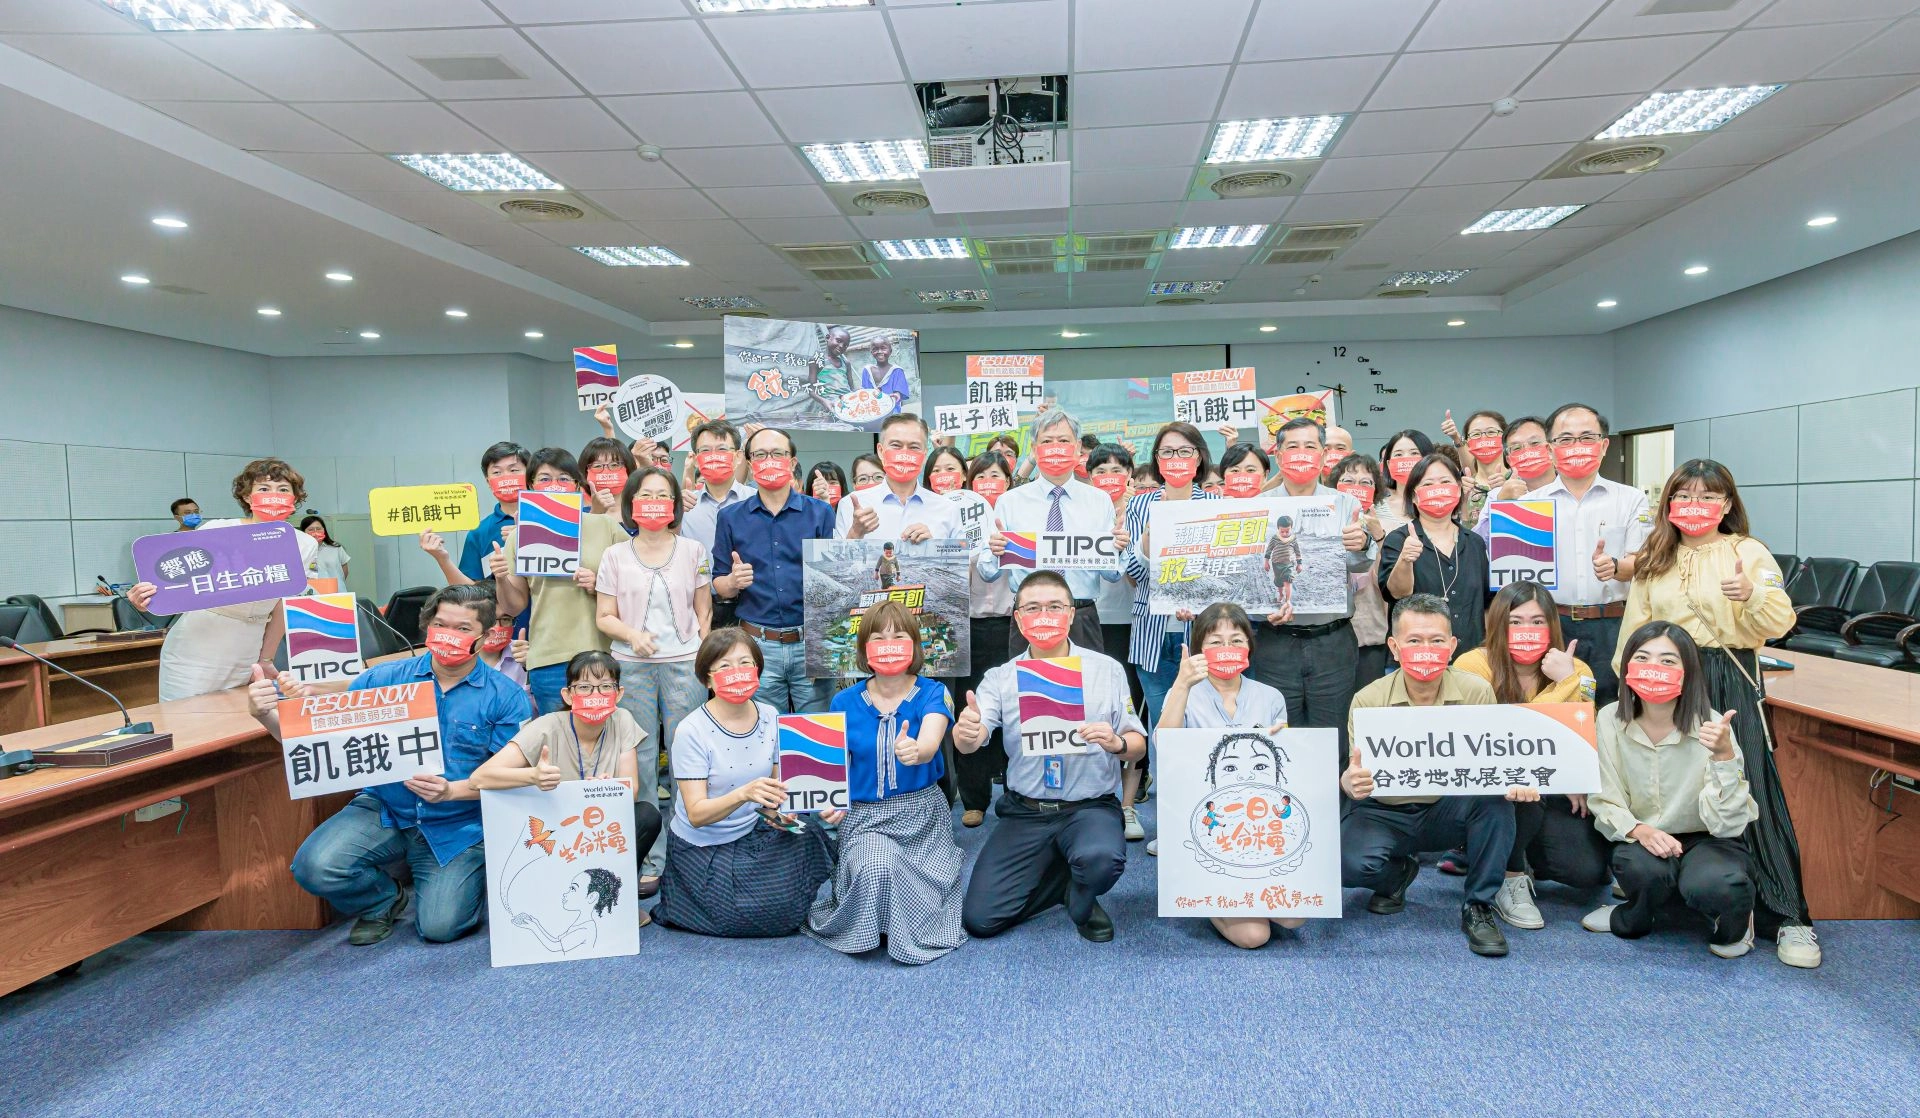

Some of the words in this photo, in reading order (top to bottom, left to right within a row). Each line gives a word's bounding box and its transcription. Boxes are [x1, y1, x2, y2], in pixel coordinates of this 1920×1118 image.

[1333, 346, 1347, 357] 12
[1221, 368, 1247, 380] NOW
[1151, 383, 1171, 391] TIPC
[1374, 384, 1398, 394] Three
[617, 386, 673, 423] 飢餓中
[939, 406, 1013, 432] 肚子餓
[895, 453, 917, 463] RESCUE
[1565, 447, 1593, 457] RESCUE
[1426, 488, 1451, 498] RESCUE
[387, 503, 461, 523] #飢餓中
[1679, 507, 1710, 516] RESCUE
[1042, 536, 1115, 556] TIPC
[1166, 546, 1208, 555] RESCUE
[1209, 548, 1237, 557] NOW!
[159, 549, 210, 579] 響應
[517, 556, 578, 574] TIPC
[164, 563, 291, 595] 一日生命糧
[1491, 568, 1555, 586] TIPC
[1033, 616, 1059, 626] RESCUE
[434, 633, 461, 647] RESCUE
[1513, 632, 1540, 641] RESCUE
[878, 645, 905, 655] RESCUE
[1216, 651, 1242, 661] RESCUE
[1413, 651, 1440, 661] RESCUE
[291, 658, 361, 681] TIPC
[1638, 667, 1669, 680] RESCUE
[725, 671, 751, 684] RESCUE
[300, 689, 371, 717] RESCUE
[373, 682, 421, 706] NOW
[582, 697, 609, 707] RESCUE
[313, 705, 406, 730] 搶救最脆弱兒童
[1021, 729, 1087, 751] TIPC
[1365, 731, 1456, 759] World
[1463, 731, 1557, 757] Vision
[288, 726, 439, 786] 飢餓中
[784, 789, 848, 810] TIPC
[1223, 796, 1269, 821] 一日
[559, 806, 605, 829] 一日
[1175, 895, 1214, 908] 你的一天
[1217, 891, 1255, 908] 我的一餐
